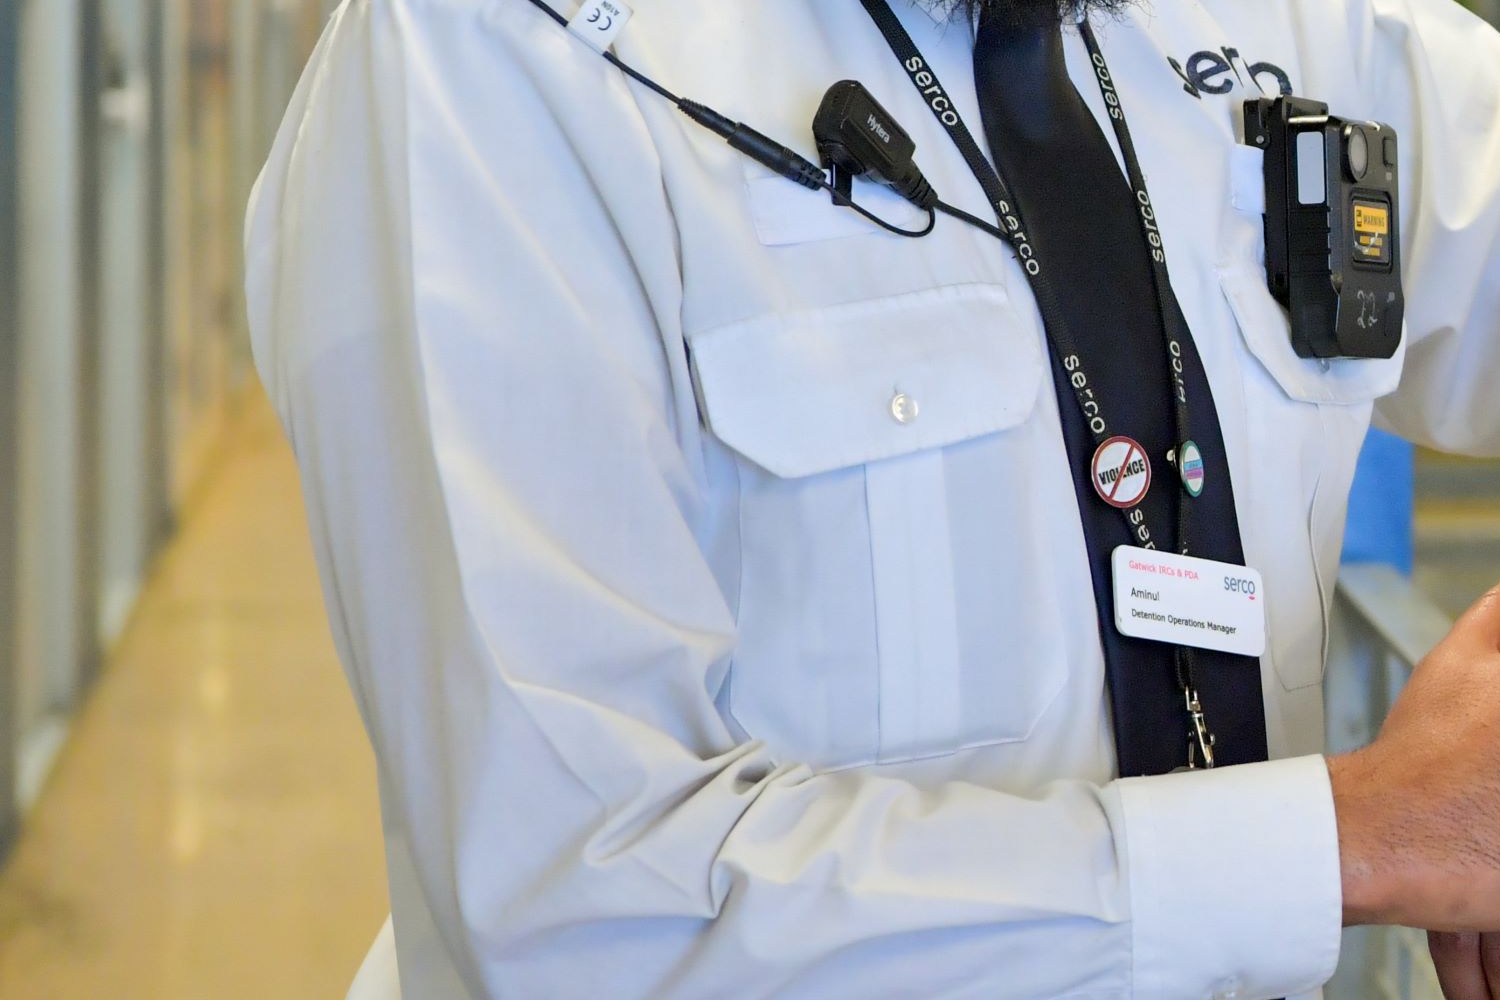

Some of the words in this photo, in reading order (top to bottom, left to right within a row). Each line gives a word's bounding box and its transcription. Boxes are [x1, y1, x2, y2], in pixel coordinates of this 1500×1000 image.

[905, 56, 958, 126] serco
[1092, 53, 1123, 121] serco
[866, 114, 890, 143] Hytera
[997, 200, 1040, 276] serco
[1137, 190, 1164, 263] serco
[1064, 354, 1105, 434] serco
[1131, 587, 1160, 601] Aminul
[1131, 608, 1166, 623] Detention
[1167, 614, 1205, 629] Operations
[1207, 621, 1236, 635] Manager
[1224, 575, 1256, 600] serco
